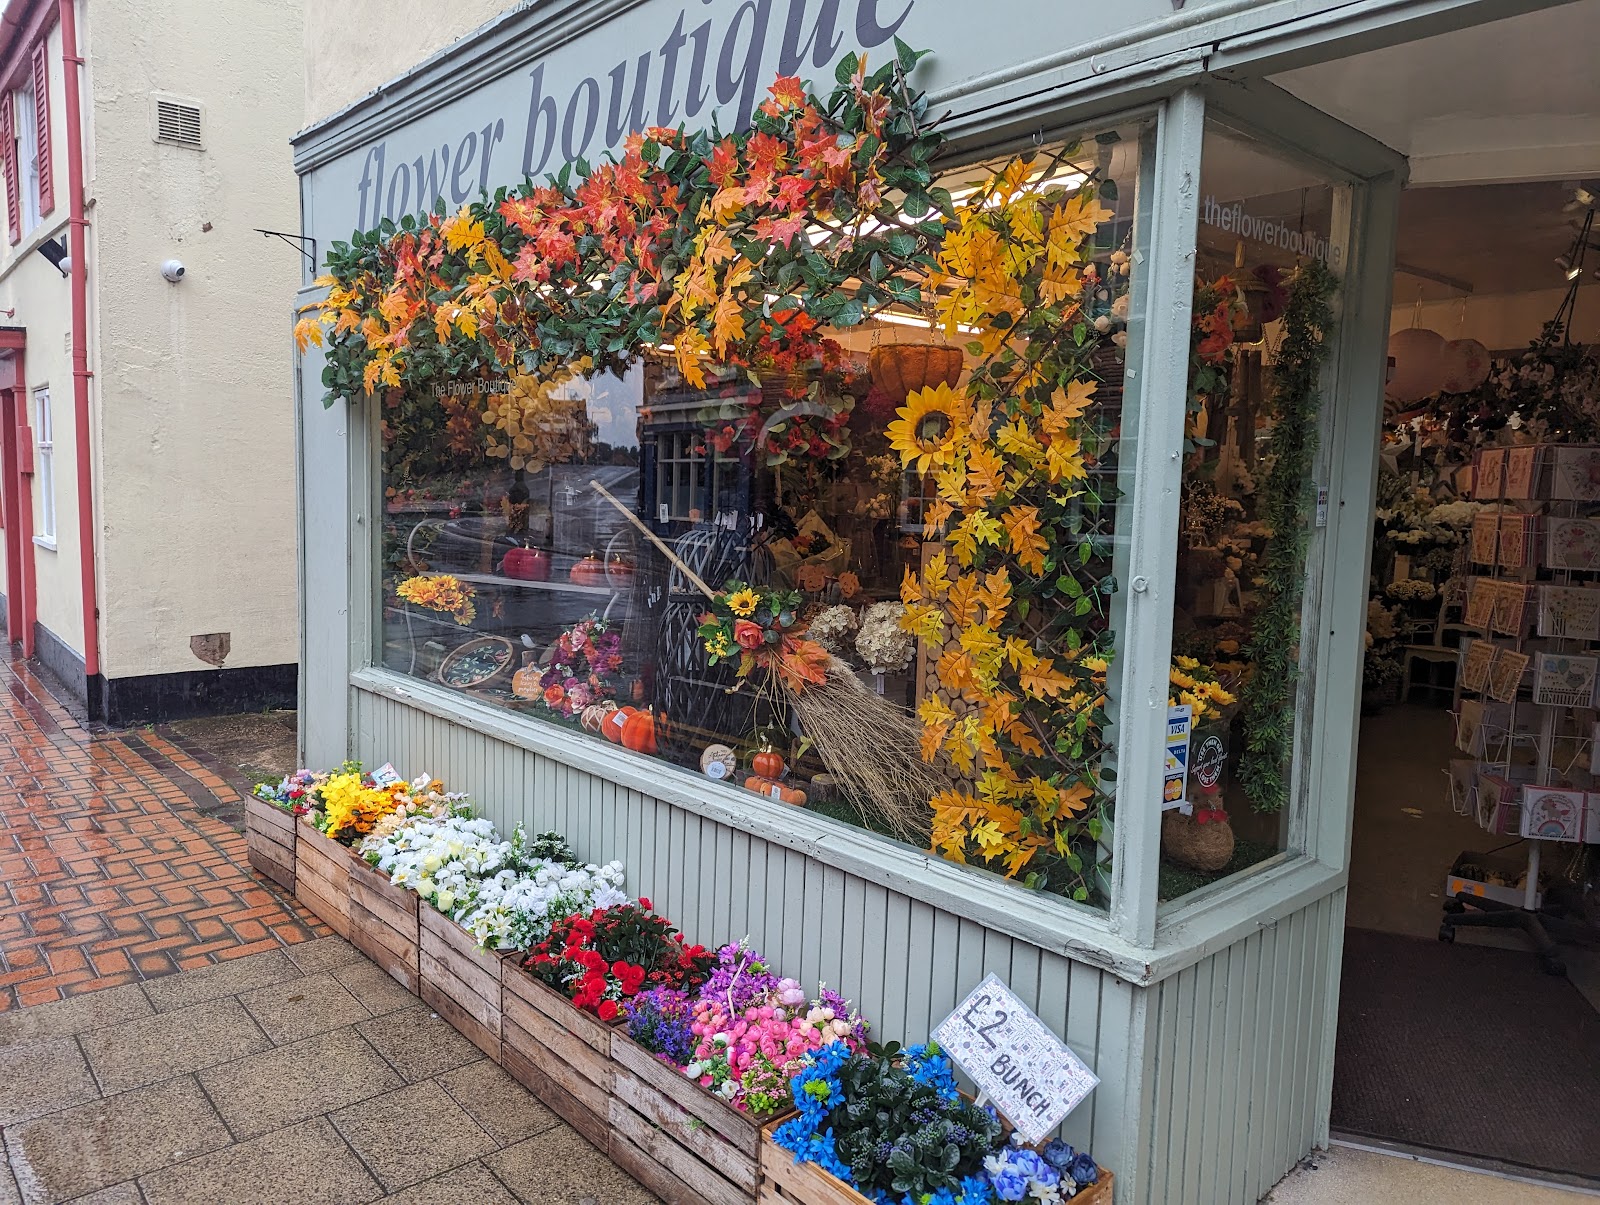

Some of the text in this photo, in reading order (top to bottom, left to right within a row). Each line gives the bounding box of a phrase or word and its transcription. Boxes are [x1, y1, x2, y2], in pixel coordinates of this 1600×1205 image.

[358, 118, 505, 234] flower
[1204, 195, 1341, 268] theflowerboutique
[430, 376, 517, 398] The Flower Boutique
[1171, 725, 1185, 734] VISA
[962, 994, 1008, 1050] £2
[990, 1052, 1052, 1118] BUNCH
